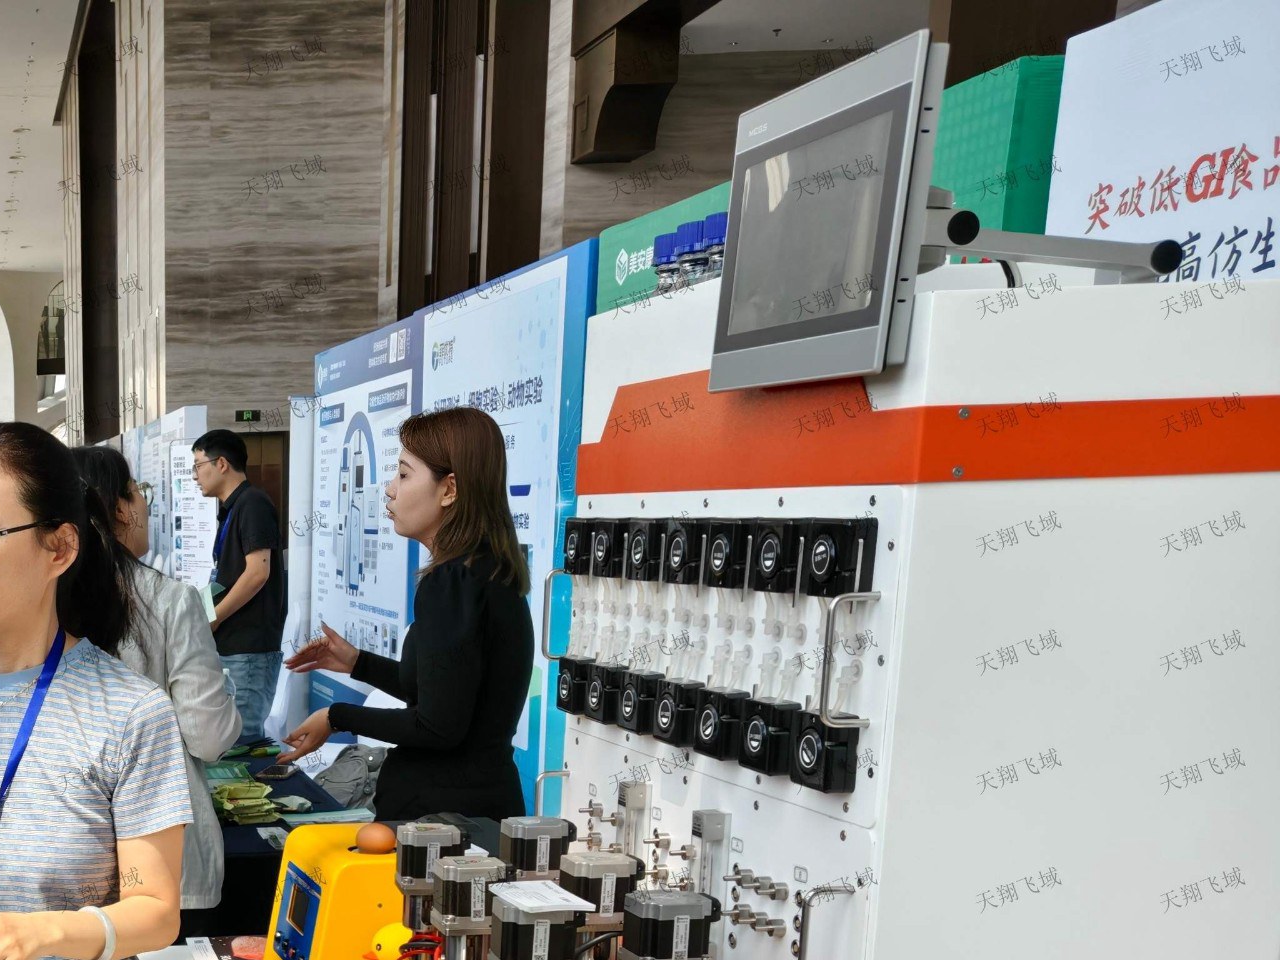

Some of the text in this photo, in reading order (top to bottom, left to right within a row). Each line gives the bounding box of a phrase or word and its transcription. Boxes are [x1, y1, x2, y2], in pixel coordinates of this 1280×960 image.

[1155, 216, 1276, 283] 高仿生
[508, 375, 544, 411] 动物实验
